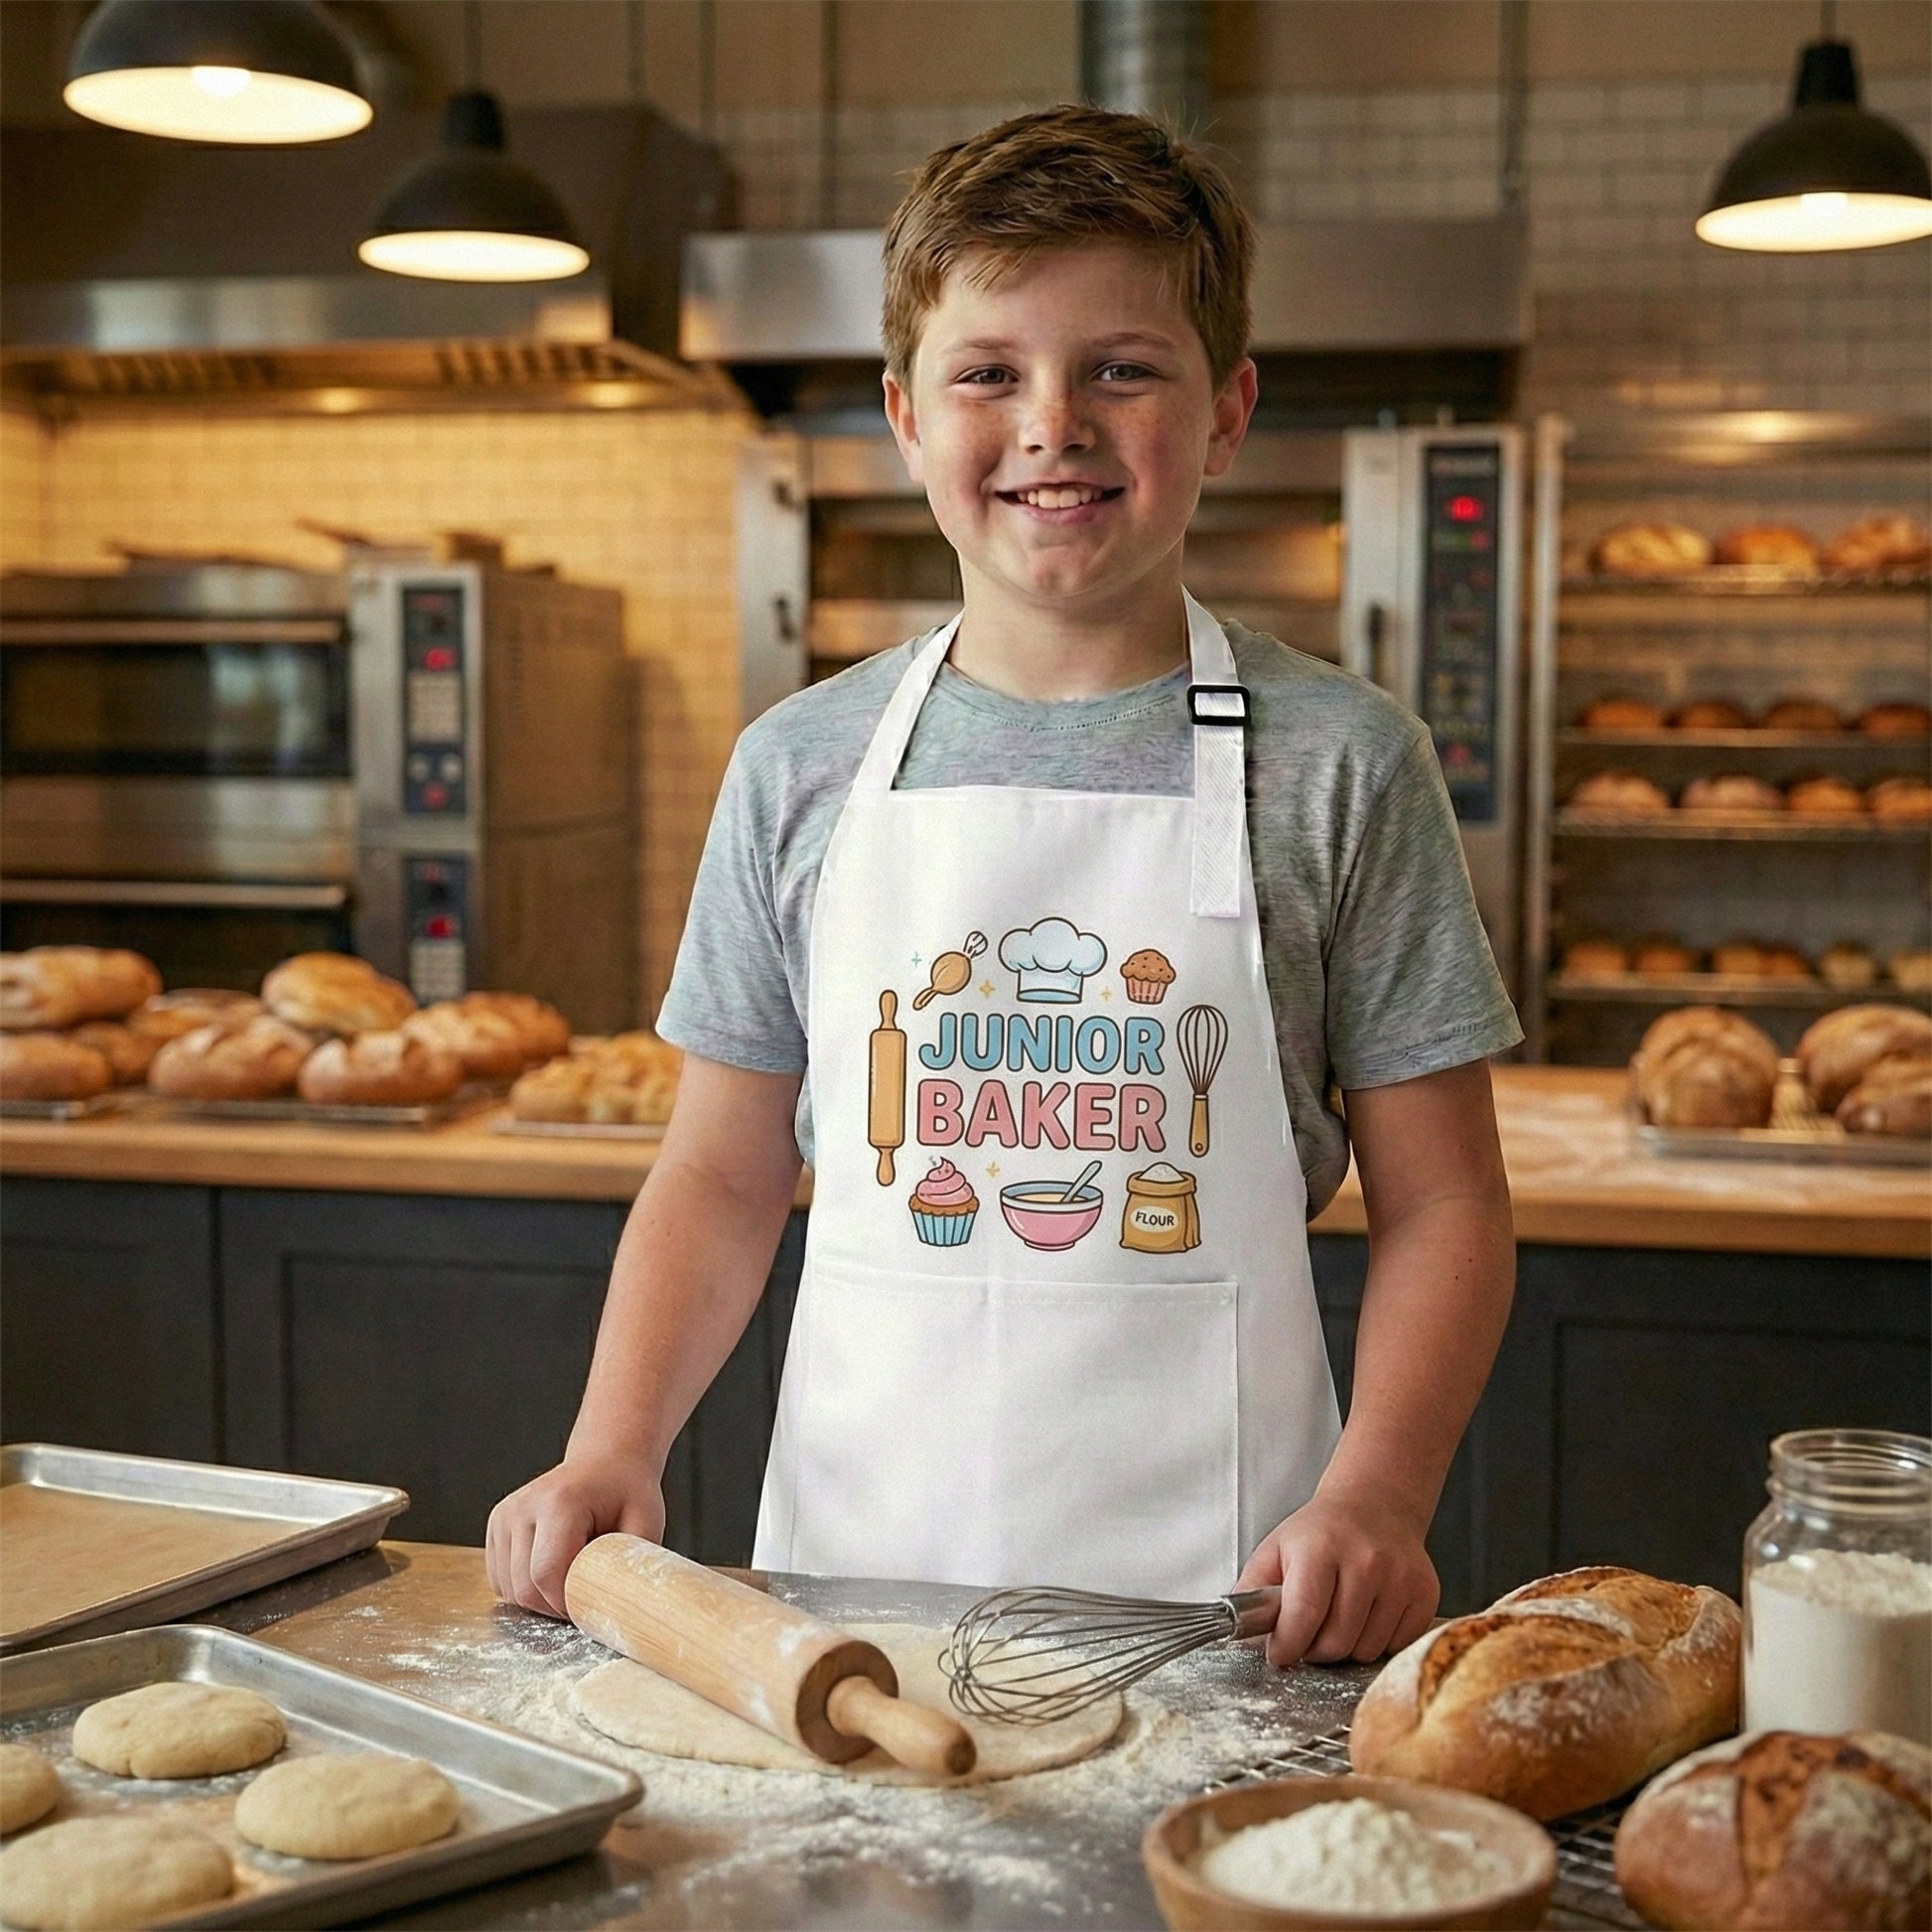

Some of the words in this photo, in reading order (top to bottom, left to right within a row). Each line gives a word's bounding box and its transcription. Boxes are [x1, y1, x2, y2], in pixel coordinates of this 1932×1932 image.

[918, 1013, 1166, 1075] JUNIOR
[917, 1078, 1167, 1153] BAKER
[1135, 1210, 1174, 1227] FLOUR
